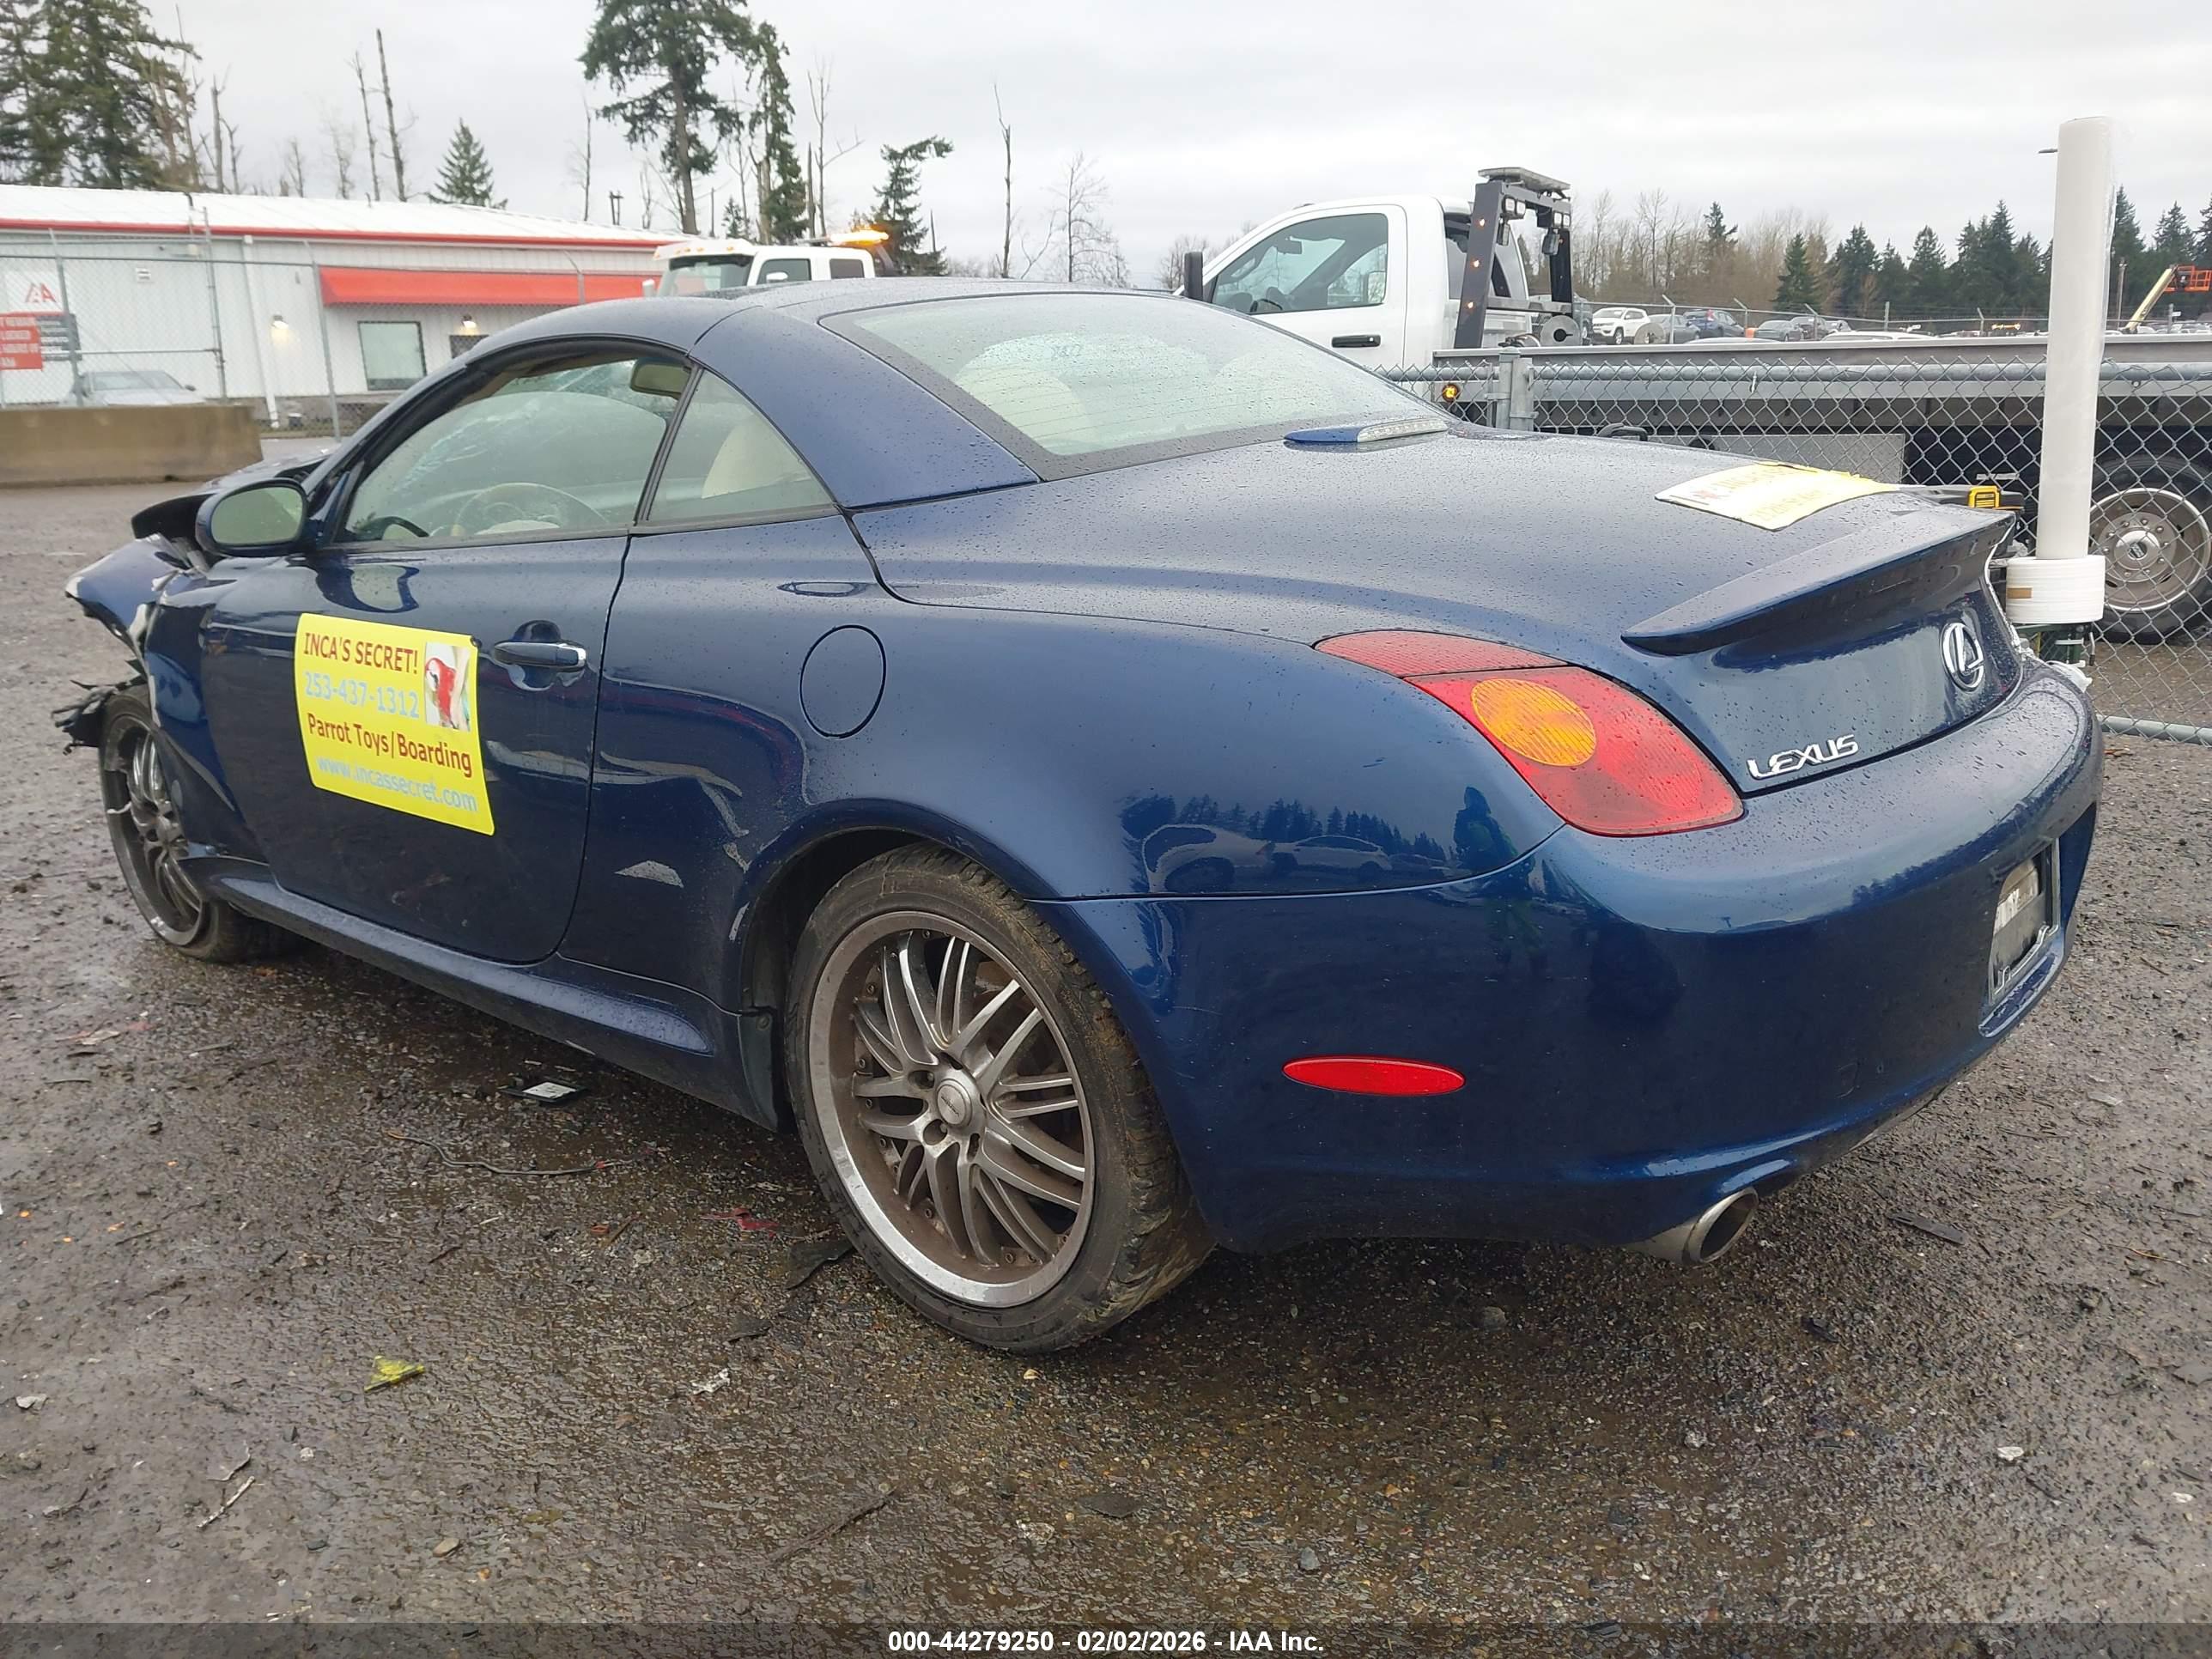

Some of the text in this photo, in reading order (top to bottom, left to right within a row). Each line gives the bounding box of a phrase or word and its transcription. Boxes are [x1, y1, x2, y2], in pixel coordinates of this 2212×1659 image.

[303, 633, 418, 674] INCA'S SECRET!
[304, 671, 419, 719] 253-437-1312
[307, 713, 352, 744] Parrot
[1747, 734, 1859, 778] LEXUS
[315, 756, 478, 811] www.incassecret.com
